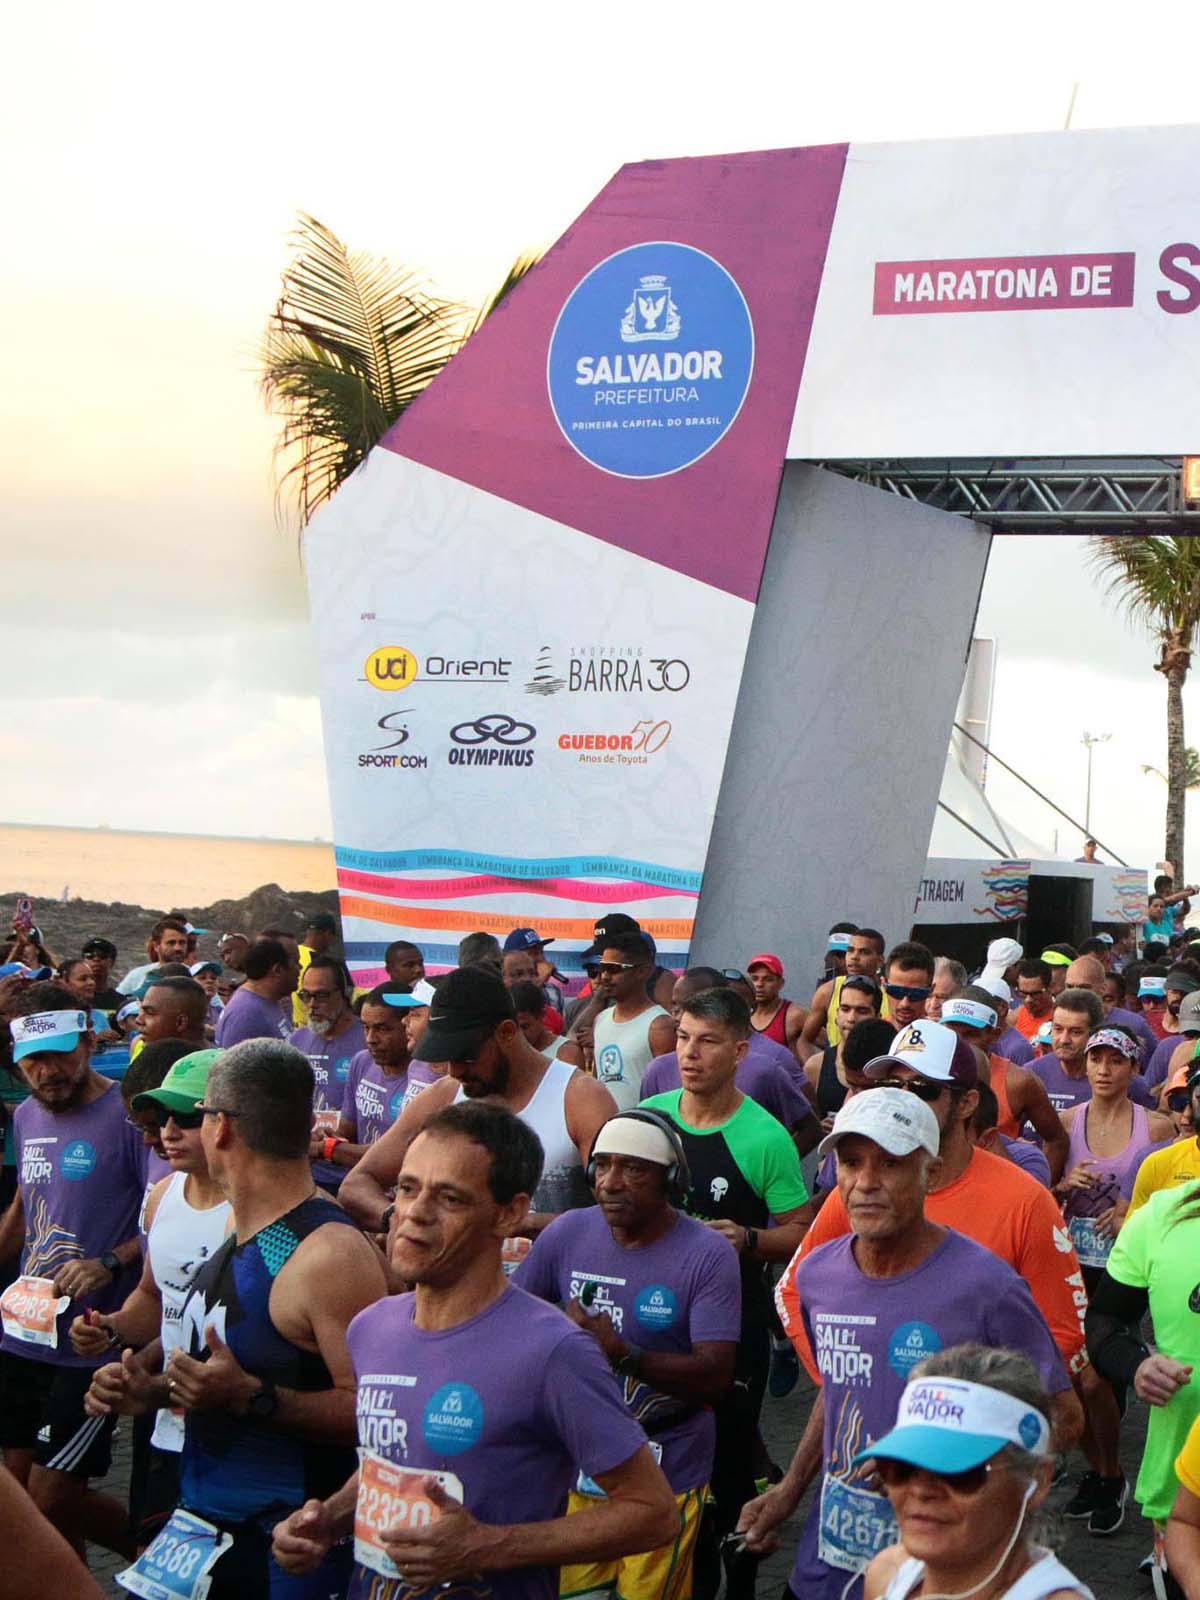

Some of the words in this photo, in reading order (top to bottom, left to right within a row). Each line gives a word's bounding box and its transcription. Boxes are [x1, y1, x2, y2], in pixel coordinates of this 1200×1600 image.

[893, 265, 1058, 303] MARATONA
[1069, 265, 1112, 297] DE
[575, 349, 723, 386] SALVADOR
[594, 386, 699, 406] PREFEITURA
[572, 419, 619, 431] PRIMEIRA
[621, 418, 664, 430] CAPITAL
[666, 417, 683, 428] DO
[685, 415, 721, 427] BRASIL
[425, 656, 512, 678] Orient
[569, 659, 643, 692] BARRA
[558, 733, 633, 751] GUEBOR
[449, 748, 535, 768] OLYMPIKUS
[578, 753, 601, 764] Anos
[603, 754, 615, 764] de
[617, 754, 648, 766] Toyota
[816, 1348, 874, 1386] VADOR
[428, 1412, 474, 1430] SALVADOR
